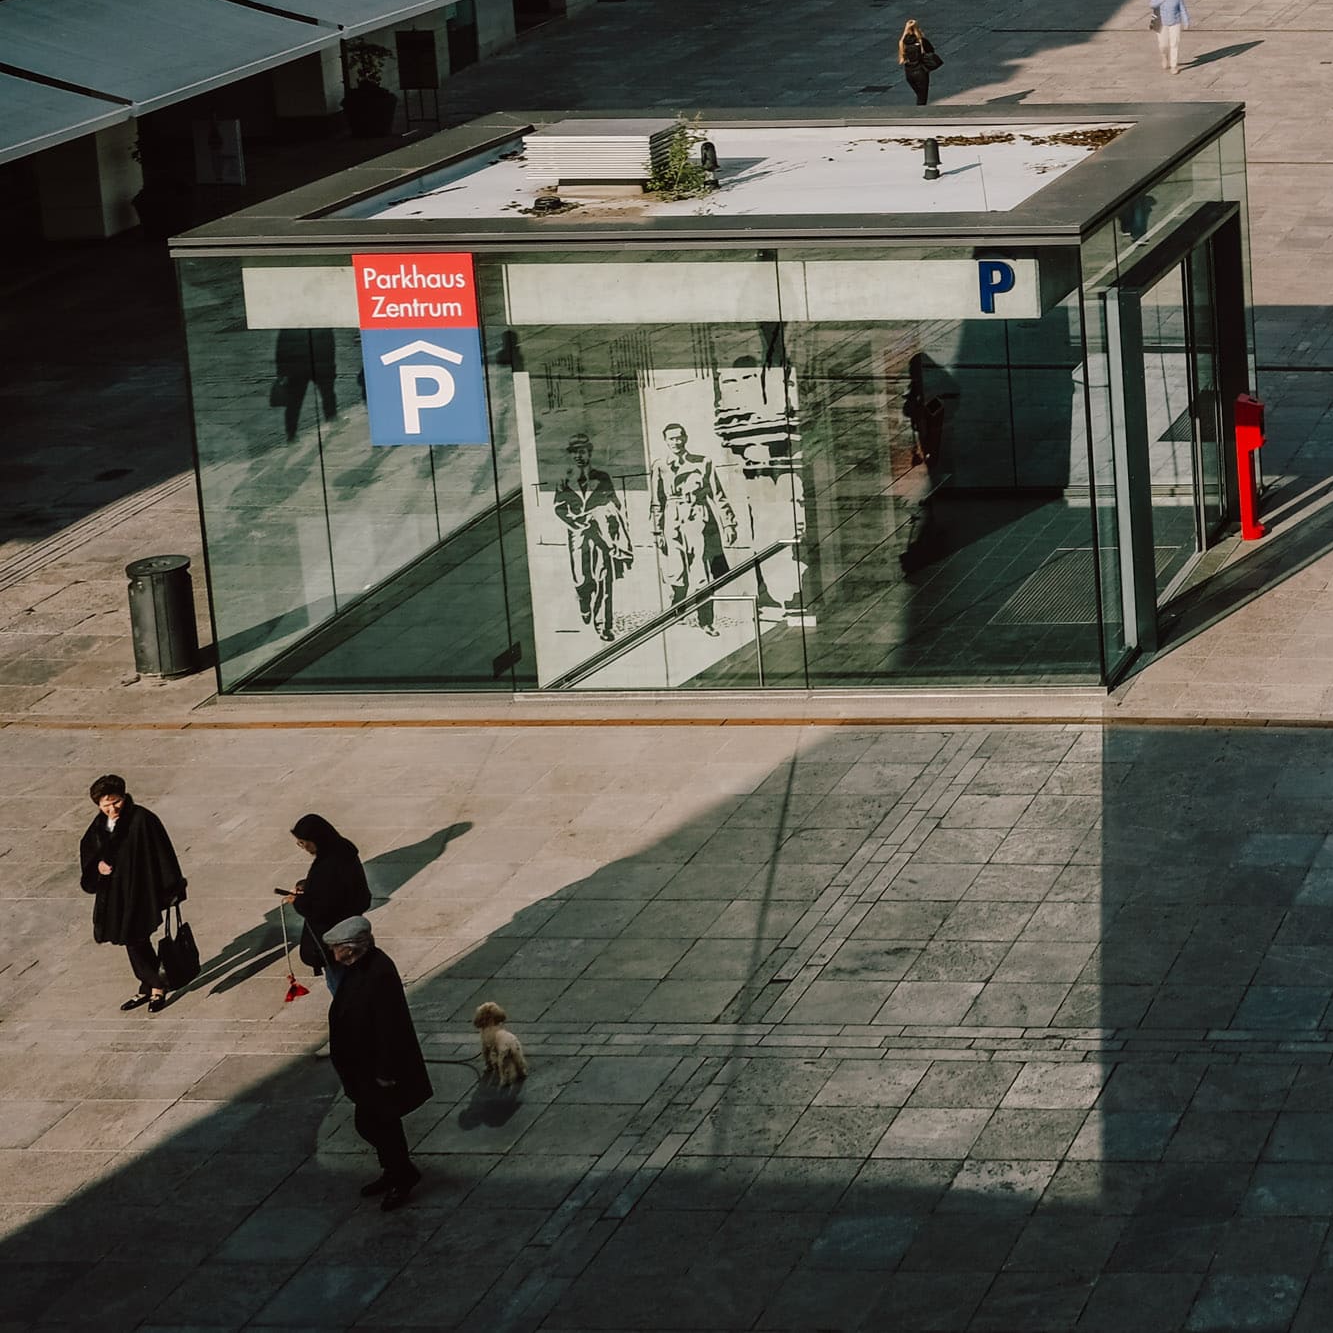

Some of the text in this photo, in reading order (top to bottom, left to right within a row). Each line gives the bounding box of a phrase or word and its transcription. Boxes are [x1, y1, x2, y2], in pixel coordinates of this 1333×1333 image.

[363, 264, 466, 290] Parkhaus
[978, 261, 1016, 314] P
[371, 296, 463, 318] Zentrum
[399, 364, 456, 435] P
